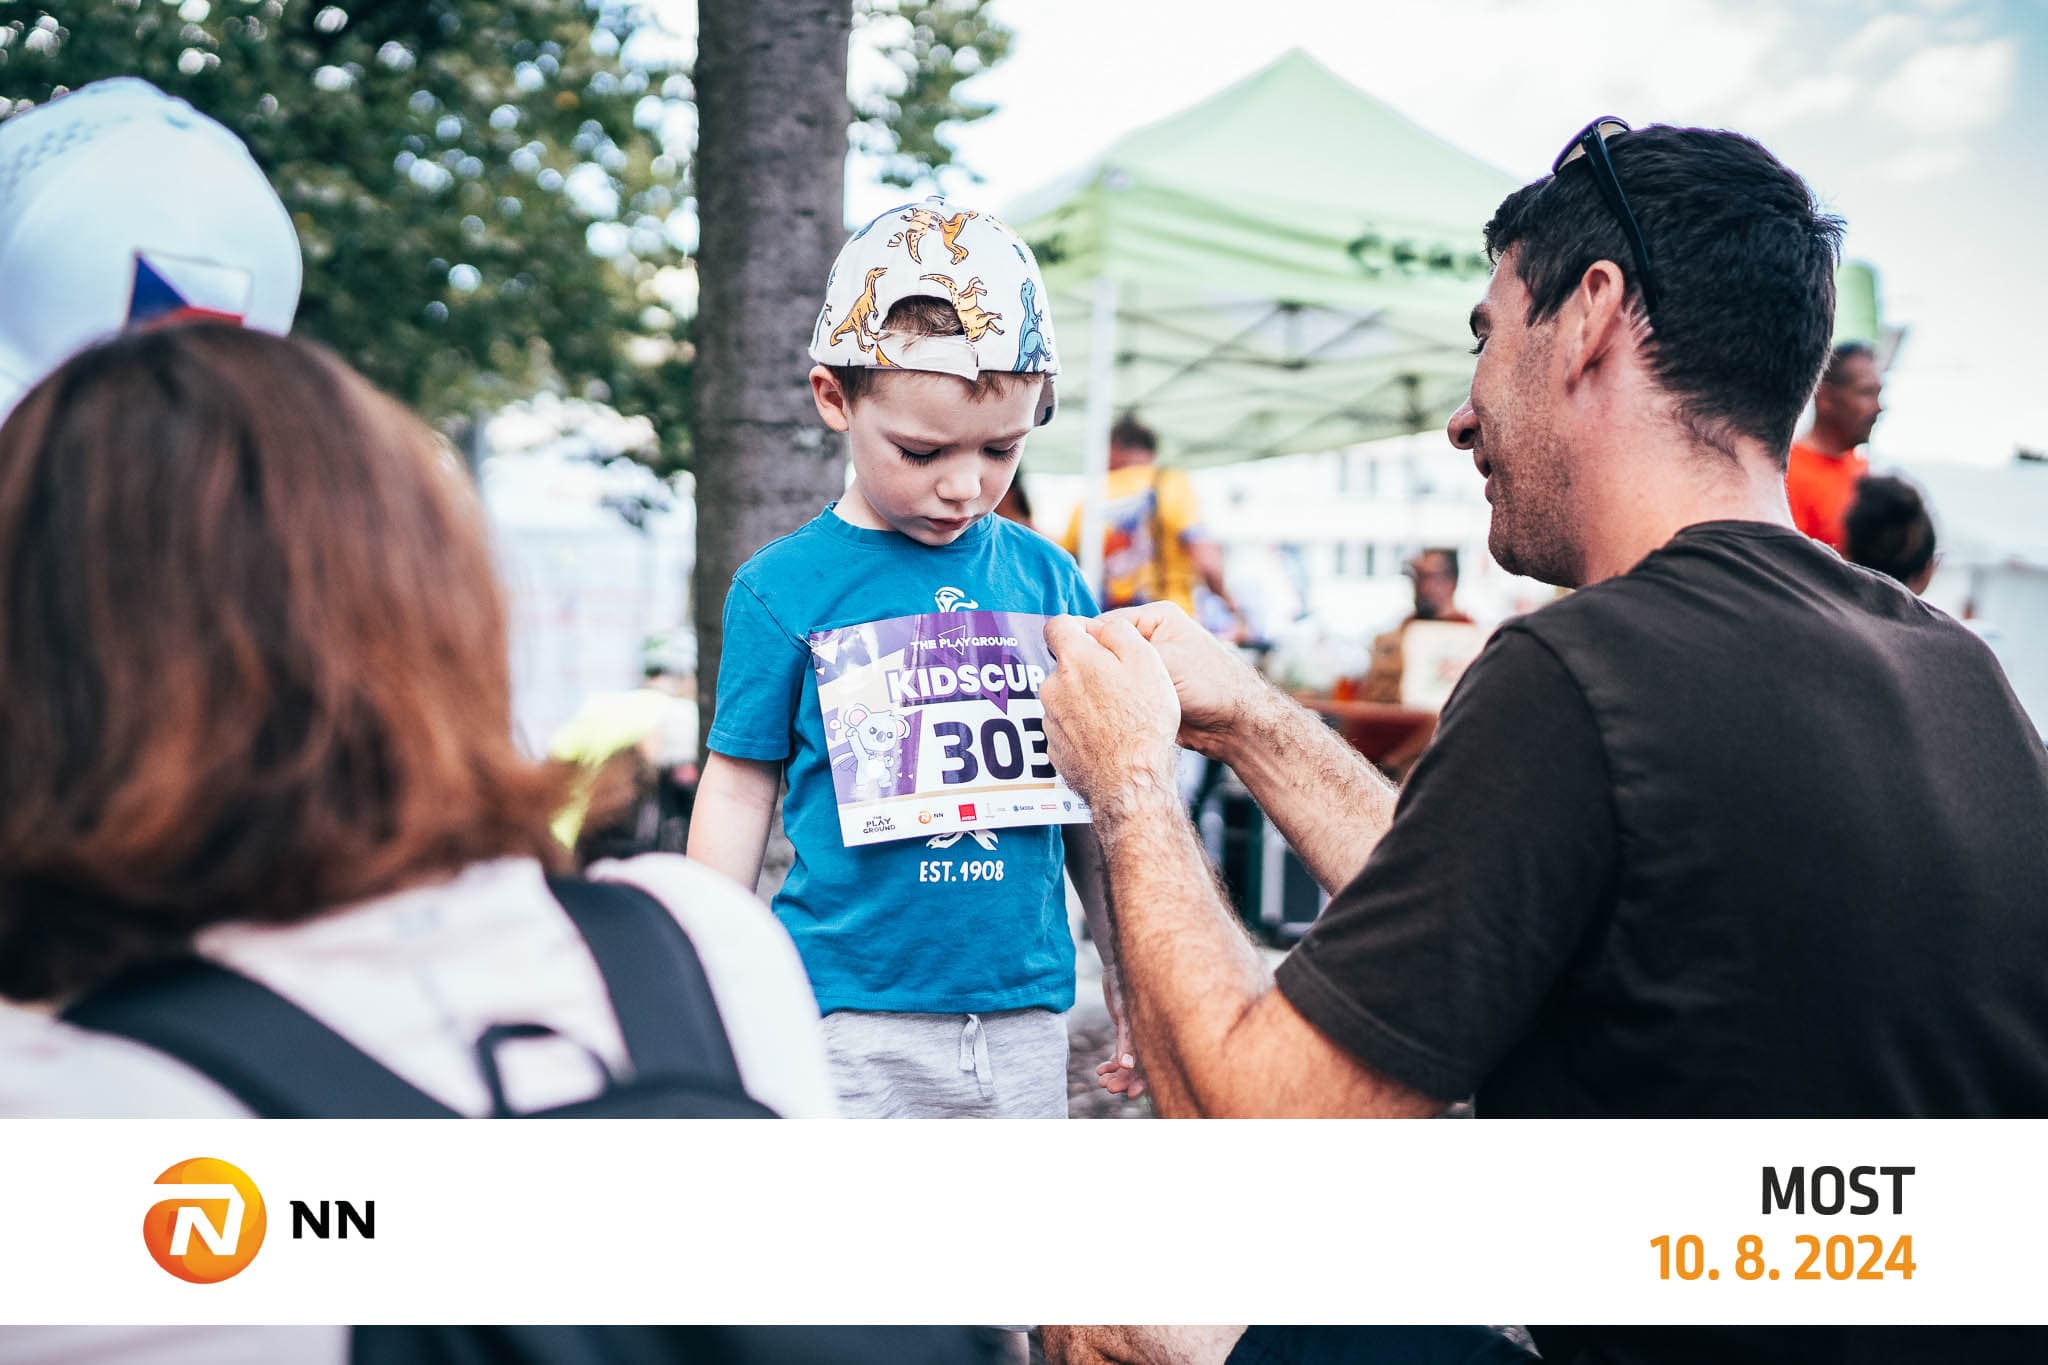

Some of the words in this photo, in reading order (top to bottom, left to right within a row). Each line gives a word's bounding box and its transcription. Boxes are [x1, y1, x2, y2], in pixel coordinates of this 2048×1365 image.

[910, 639, 937, 651] THE
[940, 636, 1018, 649] PLAYGROUND
[888, 663, 1046, 700] KIDSCUP
[933, 717, 1057, 785] 303
[862, 824, 896, 834] GROUND
[865, 817, 892, 828] PLAY
[919, 860, 957, 883] EST.
[960, 860, 1005, 882] 1908
